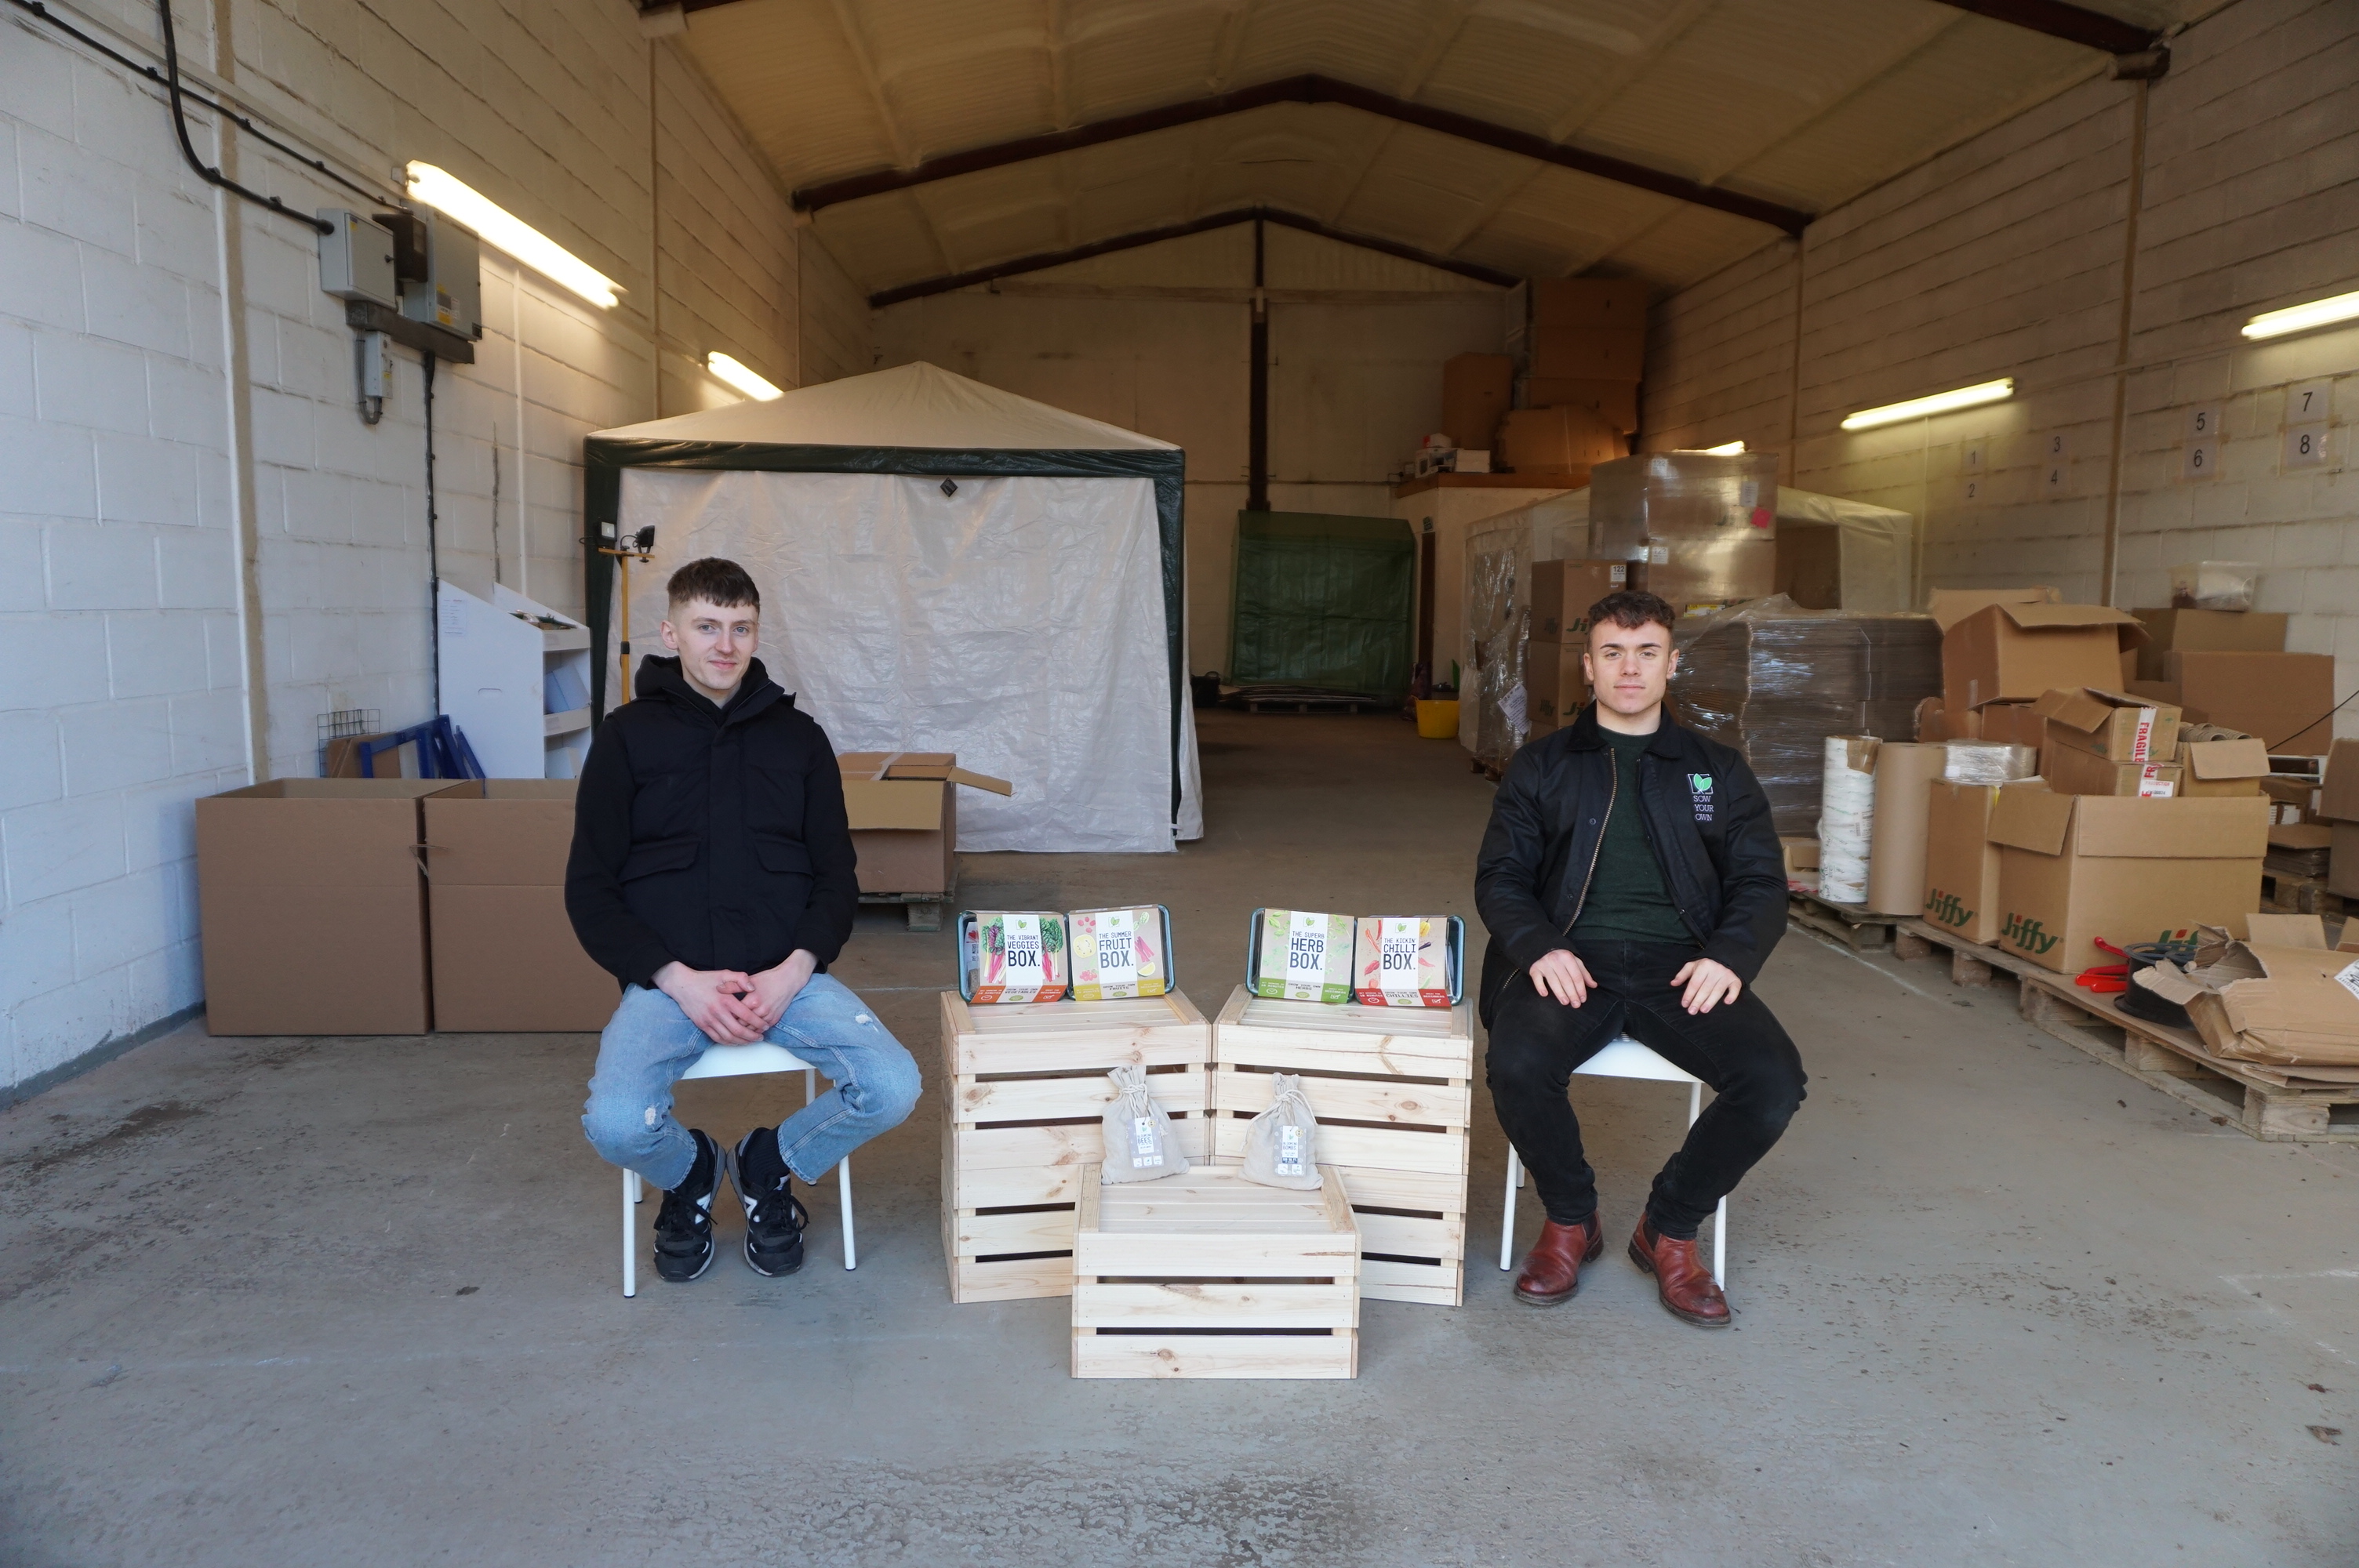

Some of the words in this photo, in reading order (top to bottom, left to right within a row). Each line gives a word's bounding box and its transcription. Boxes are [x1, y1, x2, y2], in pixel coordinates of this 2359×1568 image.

[2303, 391, 2313, 412] 7
[2196, 412, 2205, 430] 5
[2054, 436, 2060, 452] 3
[2299, 434, 2310, 454] 8
[1971, 450, 1976, 464] 1
[2194, 448, 2203, 467] 6
[2051, 470, 2058, 485] 4
[1968, 483, 1976, 498] 2
[1926, 888, 1974, 927] Jiffy
[2001, 912, 2058, 954] Jiffy
[1099, 938, 1132, 951] FRUIT
[1291, 938, 1324, 953] HERB
[1384, 944, 1416, 953] CHILLI
[1008, 950, 1040, 967] BOX.
[1100, 950, 1134, 968] BOX.
[1290, 952, 1322, 970] BOX.
[1383, 953, 1416, 970] BOX.
